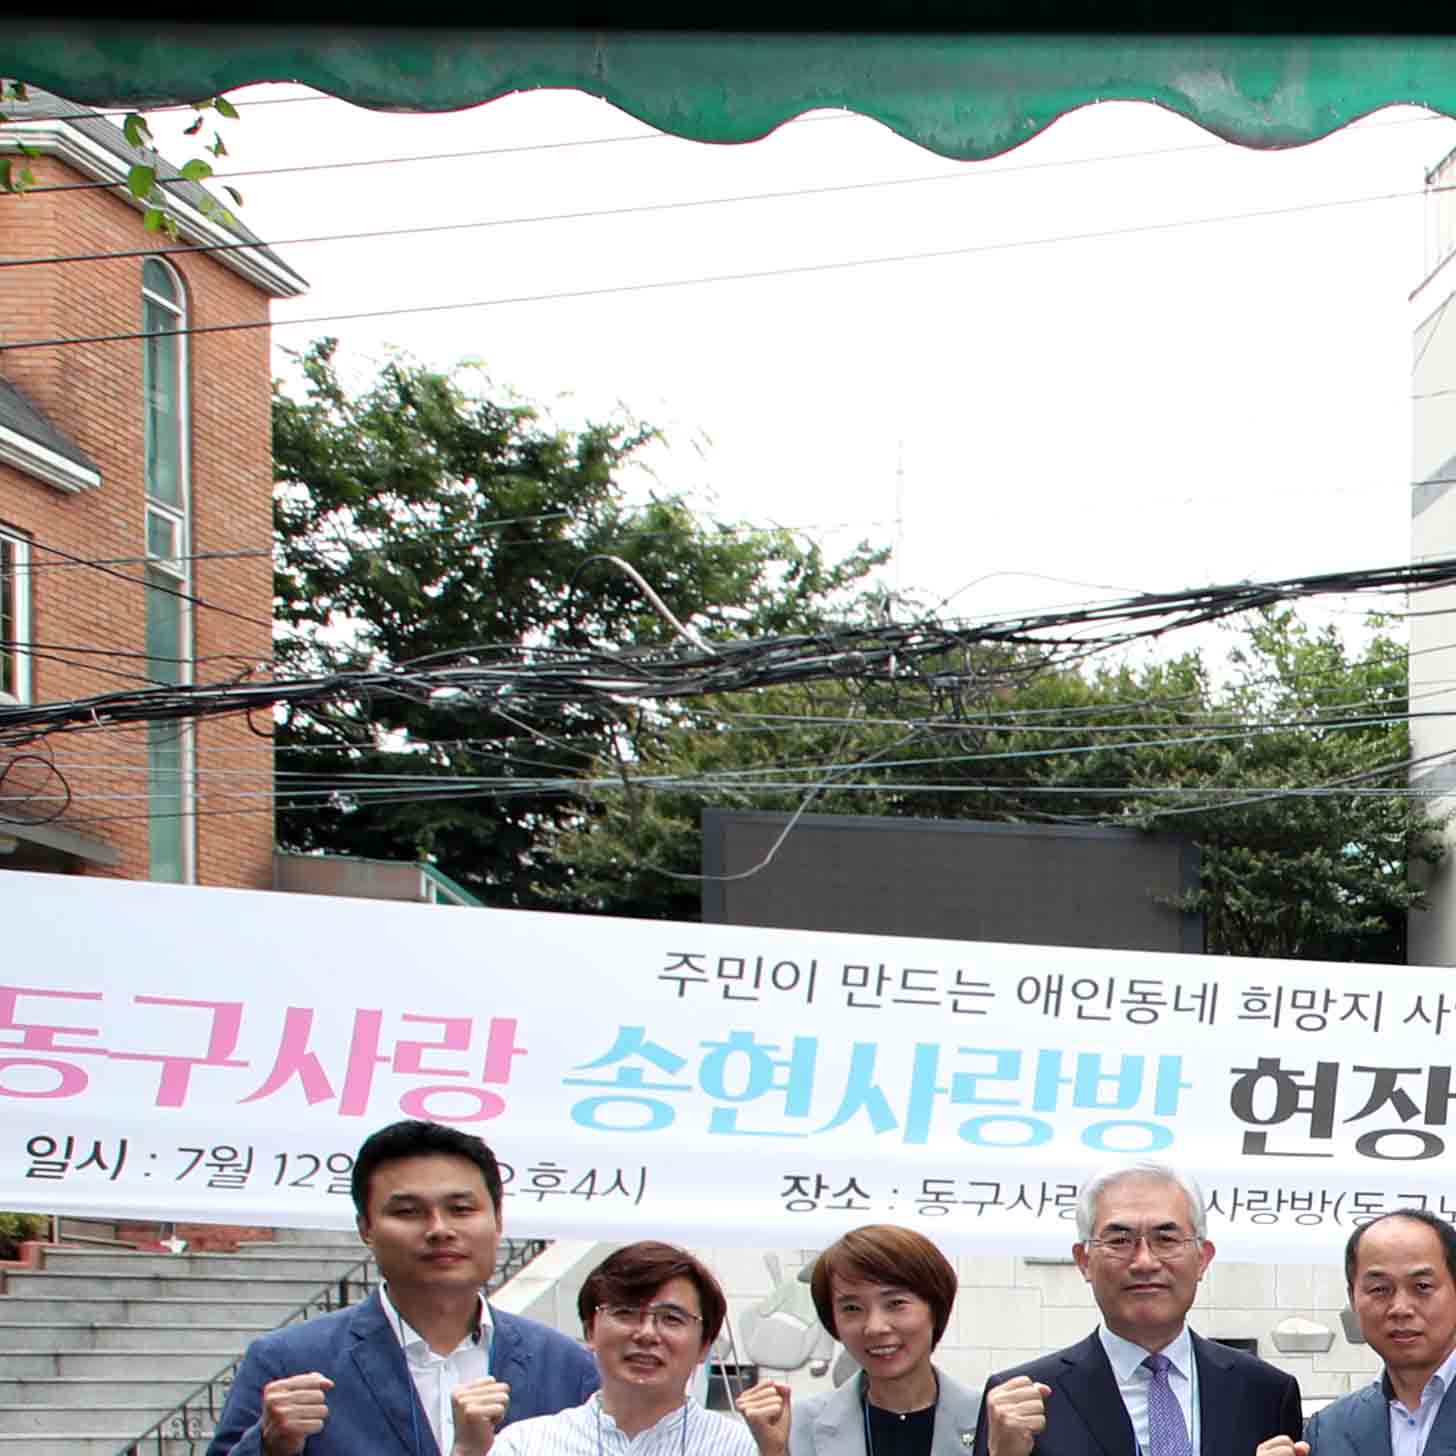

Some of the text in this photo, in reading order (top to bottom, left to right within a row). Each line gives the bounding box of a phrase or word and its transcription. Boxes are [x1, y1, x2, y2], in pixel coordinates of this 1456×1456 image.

[657, 951, 817, 1004] 주민이
[841, 962, 996, 1016] 만드는
[1016, 973, 1219, 1026] 애인동네
[1237, 985, 1384, 1033] 희망지
[0, 985, 529, 1123] 동구사랑
[562, 1025, 1193, 1154] 송현사랑방
[26, 1135, 128, 1181] 일시
[176, 1145, 254, 1190] 7월
[780, 1173, 872, 1212] 장소
